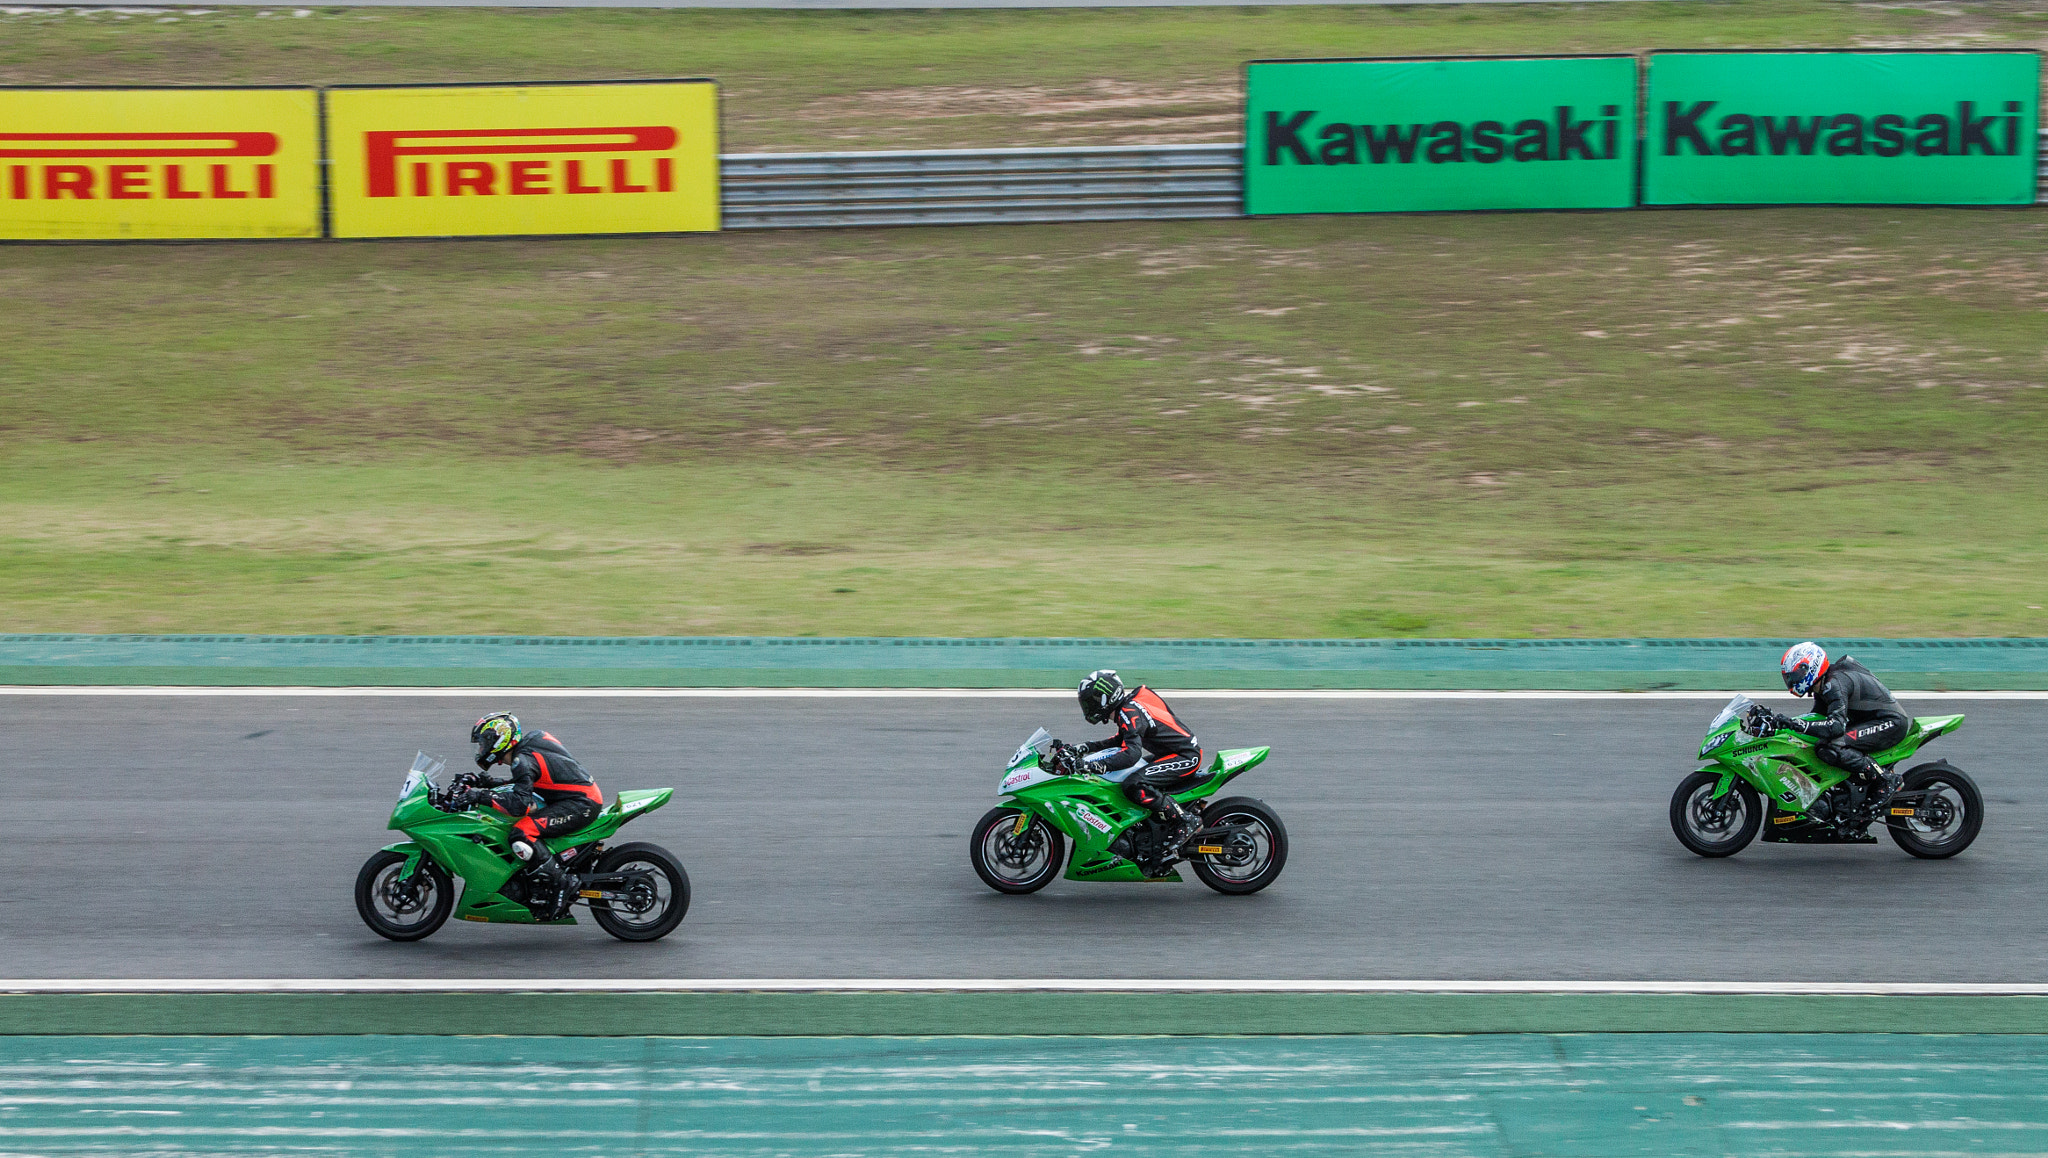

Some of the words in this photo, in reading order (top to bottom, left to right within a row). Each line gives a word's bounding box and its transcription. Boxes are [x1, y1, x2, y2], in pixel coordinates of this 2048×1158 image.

[1261, 105, 1619, 166] Kawasaki
[1661, 100, 2027, 157] Kawasaki
[363, 126, 680, 198] PIRELLI
[1006, 772, 1030, 786] Castrol
[1083, 812, 1108, 830] Castrol
[1076, 860, 1123, 877] Kawasaki
